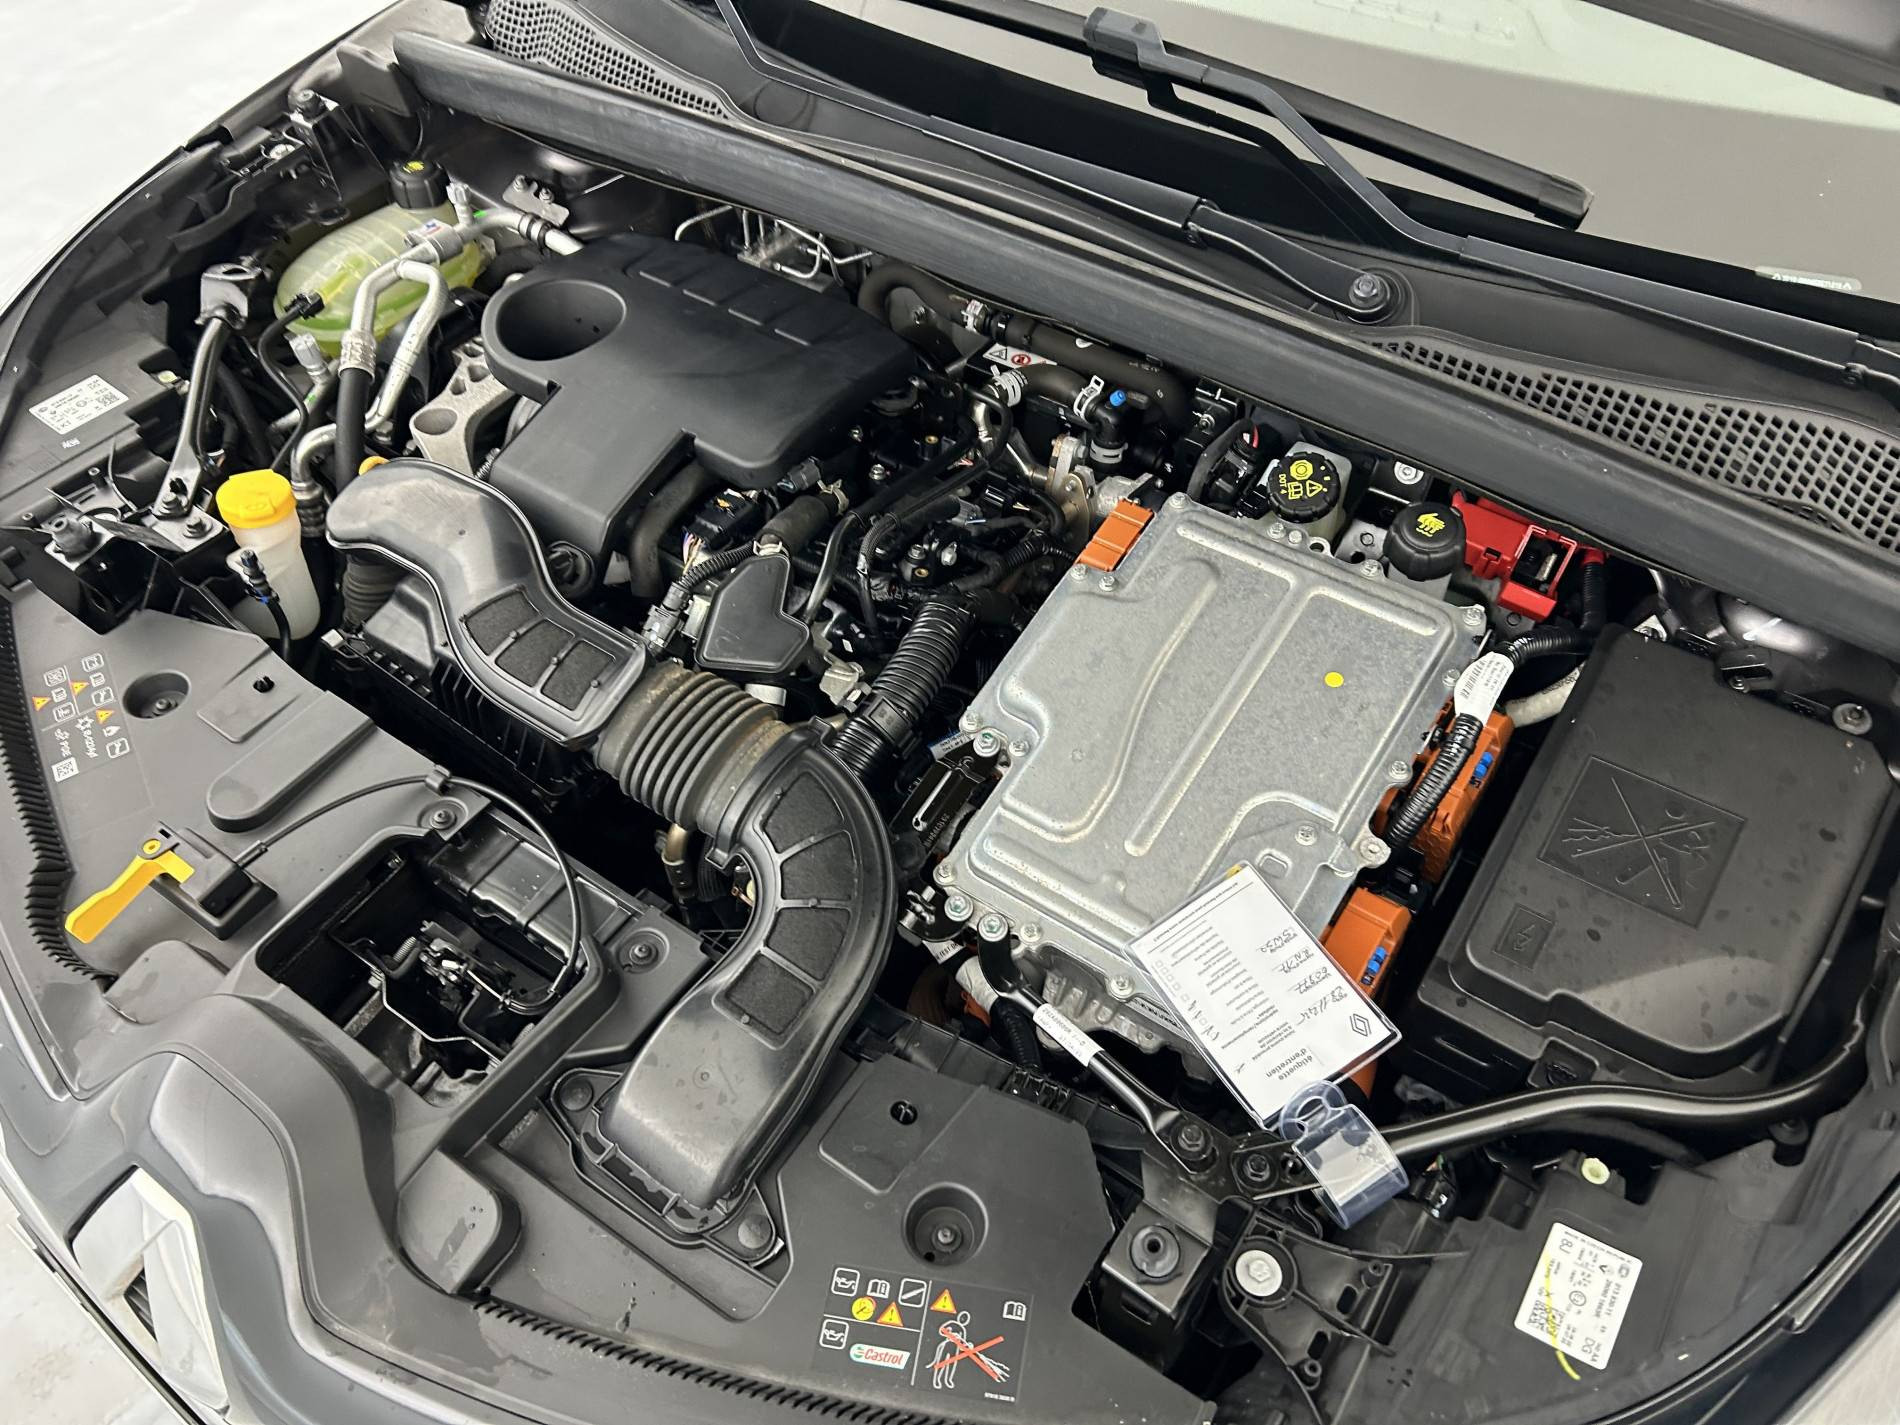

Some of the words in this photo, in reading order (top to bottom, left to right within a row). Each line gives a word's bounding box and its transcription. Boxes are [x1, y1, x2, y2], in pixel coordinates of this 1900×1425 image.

[1277, 473, 1287, 487] DOT
[1264, 1047, 1308, 1079] d'entretien
[1275, 1052, 1314, 1082] étiquette
[864, 1347, 903, 1365] Castrol
